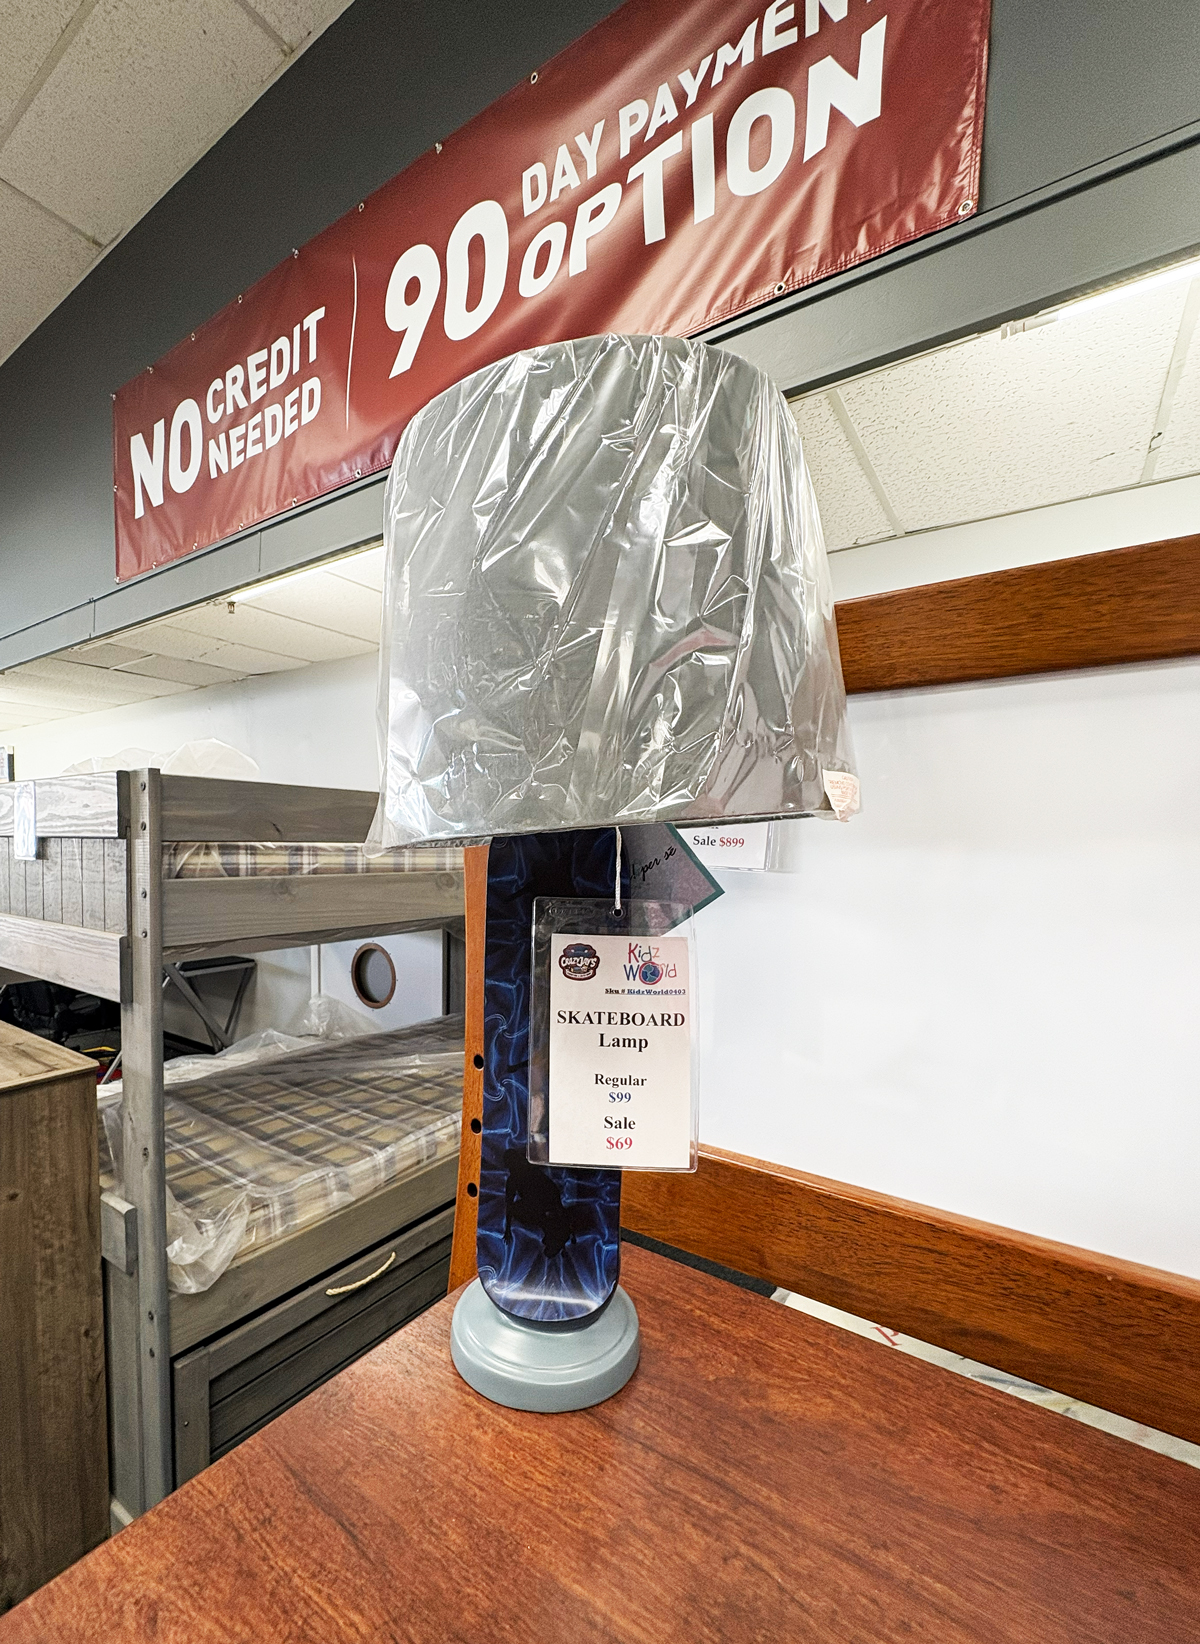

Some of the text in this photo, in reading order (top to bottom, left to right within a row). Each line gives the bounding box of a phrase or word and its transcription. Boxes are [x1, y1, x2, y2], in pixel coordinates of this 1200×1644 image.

[521, 0, 873, 218] DAY PAYMEN
[518, 15, 888, 298] OPTION
[384, 200, 510, 378] 90
[206, 306, 325, 425] CREDIT
[209, 376, 321, 479] NEEDED
[129, 397, 203, 520] NO
[693, 835, 745, 848] Sale $899
[628, 942, 660, 964] Kidz
[557, 1010, 686, 1027] SKATEBOARD
[598, 1033, 649, 1052] Lamp
[594, 1073, 647, 1088] Regular
[608, 1091, 632, 1104] $99
[603, 1116, 636, 1130] Sale
[606, 1137, 633, 1151] $69
